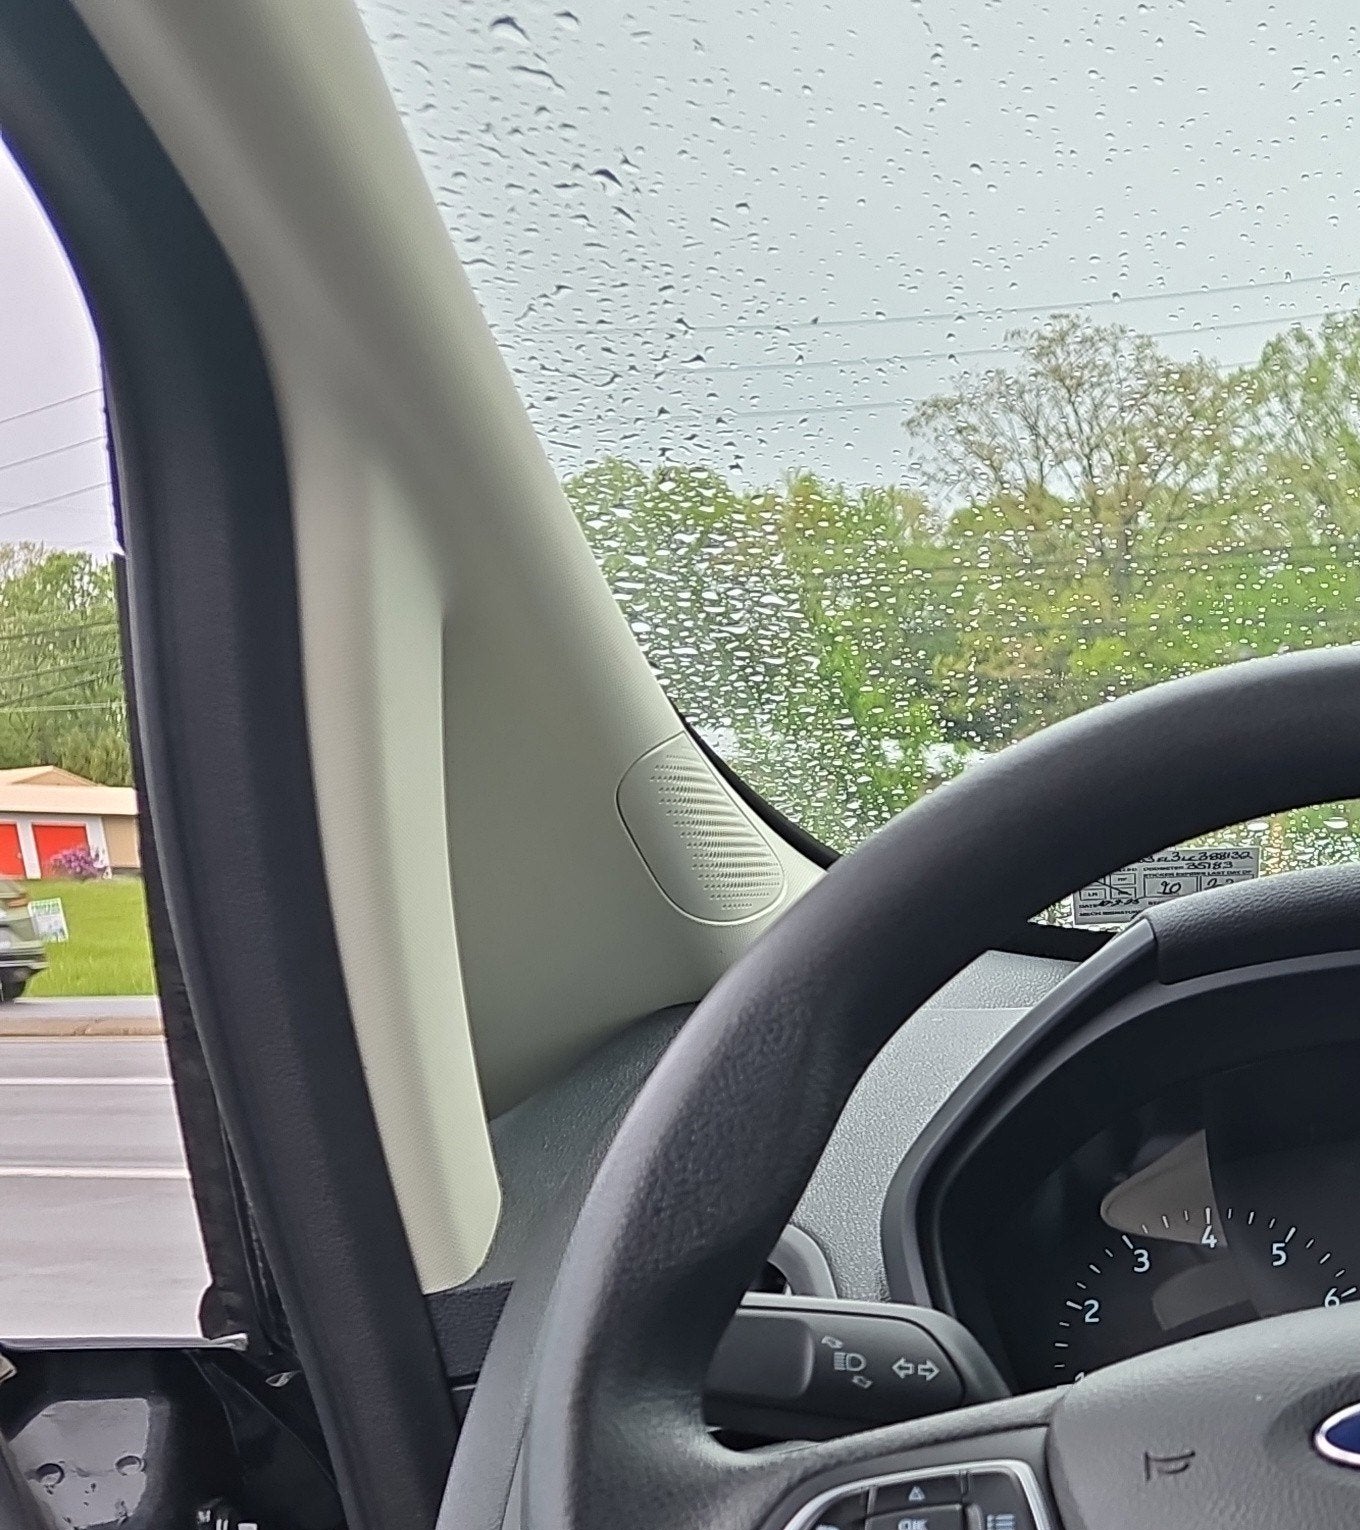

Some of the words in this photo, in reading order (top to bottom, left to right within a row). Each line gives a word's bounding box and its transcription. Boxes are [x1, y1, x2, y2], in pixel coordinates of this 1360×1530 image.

[1201, 1225, 1217, 1249] 4
[1133, 1249, 1151, 1273] 3
[1271, 1242, 1287, 1266] 5
[1324, 1287, 1341, 1309] 6
[1084, 1299, 1101, 1324] 2
